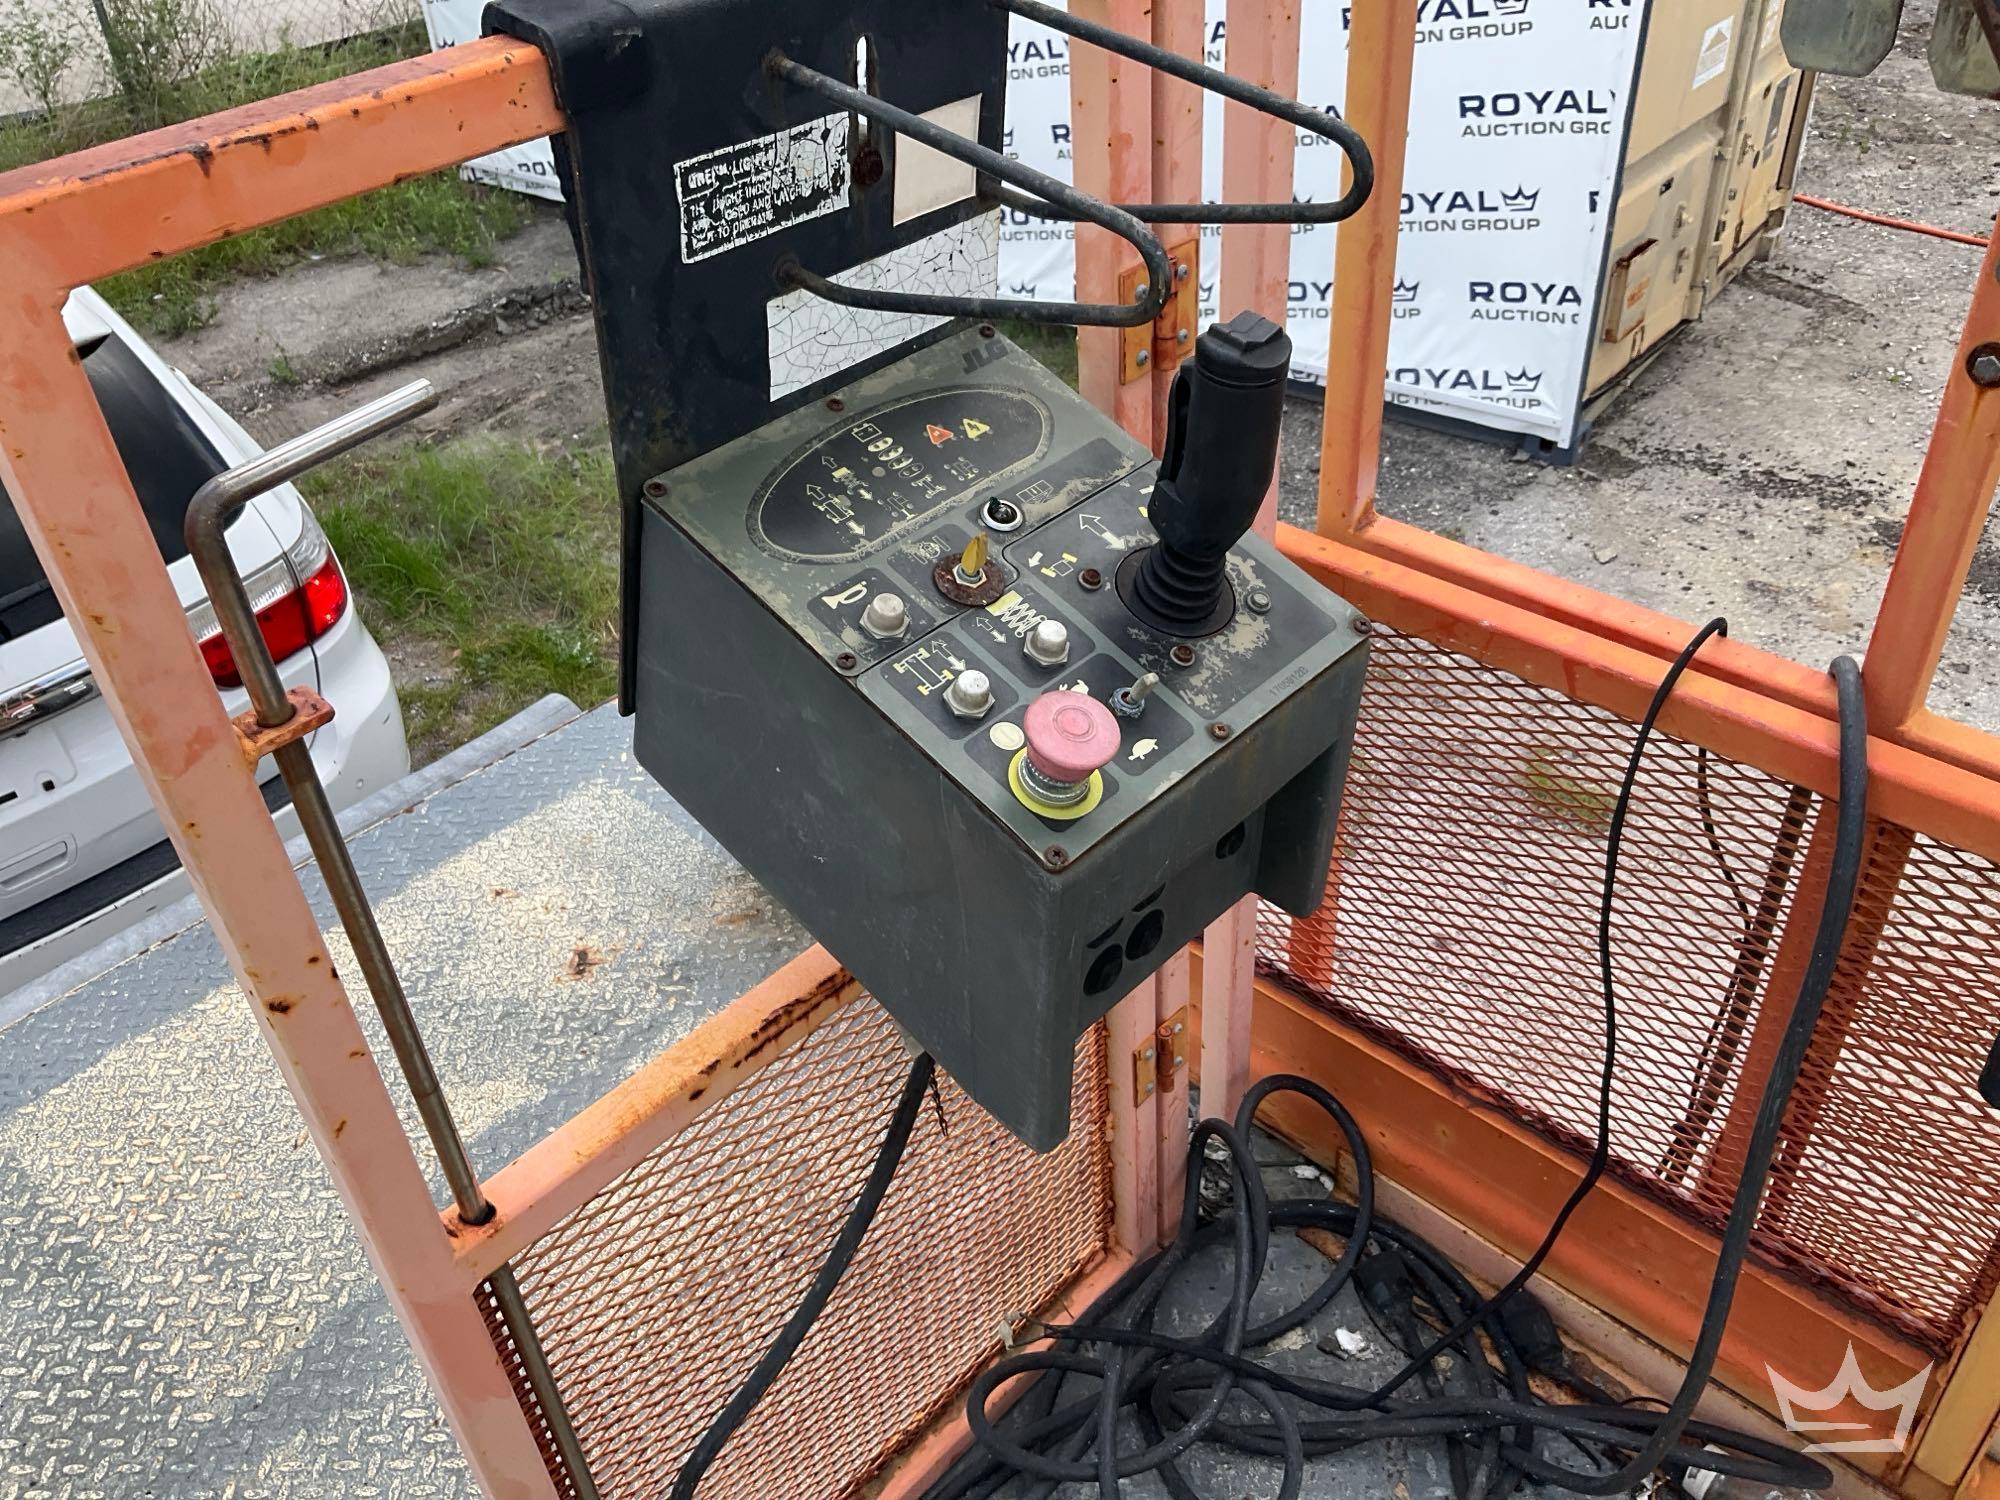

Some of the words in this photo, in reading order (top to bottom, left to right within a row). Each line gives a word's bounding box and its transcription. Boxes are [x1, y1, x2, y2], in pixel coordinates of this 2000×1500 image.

[1449, 21, 1534, 41] GROUP
[1007, 39, 1064, 63] YAL
[1458, 89, 1608, 118] ROYAL
[1461, 121, 1564, 137] AUCTION
[1000, 229, 1062, 242] UCTION
[1461, 218, 1541, 232] GROUP
[1468, 281, 1582, 306] ROYA
[1470, 308, 1566, 324] AUCTION
[961, 341, 1009, 375] JLG
[1394, 367, 1503, 391] OYAL
